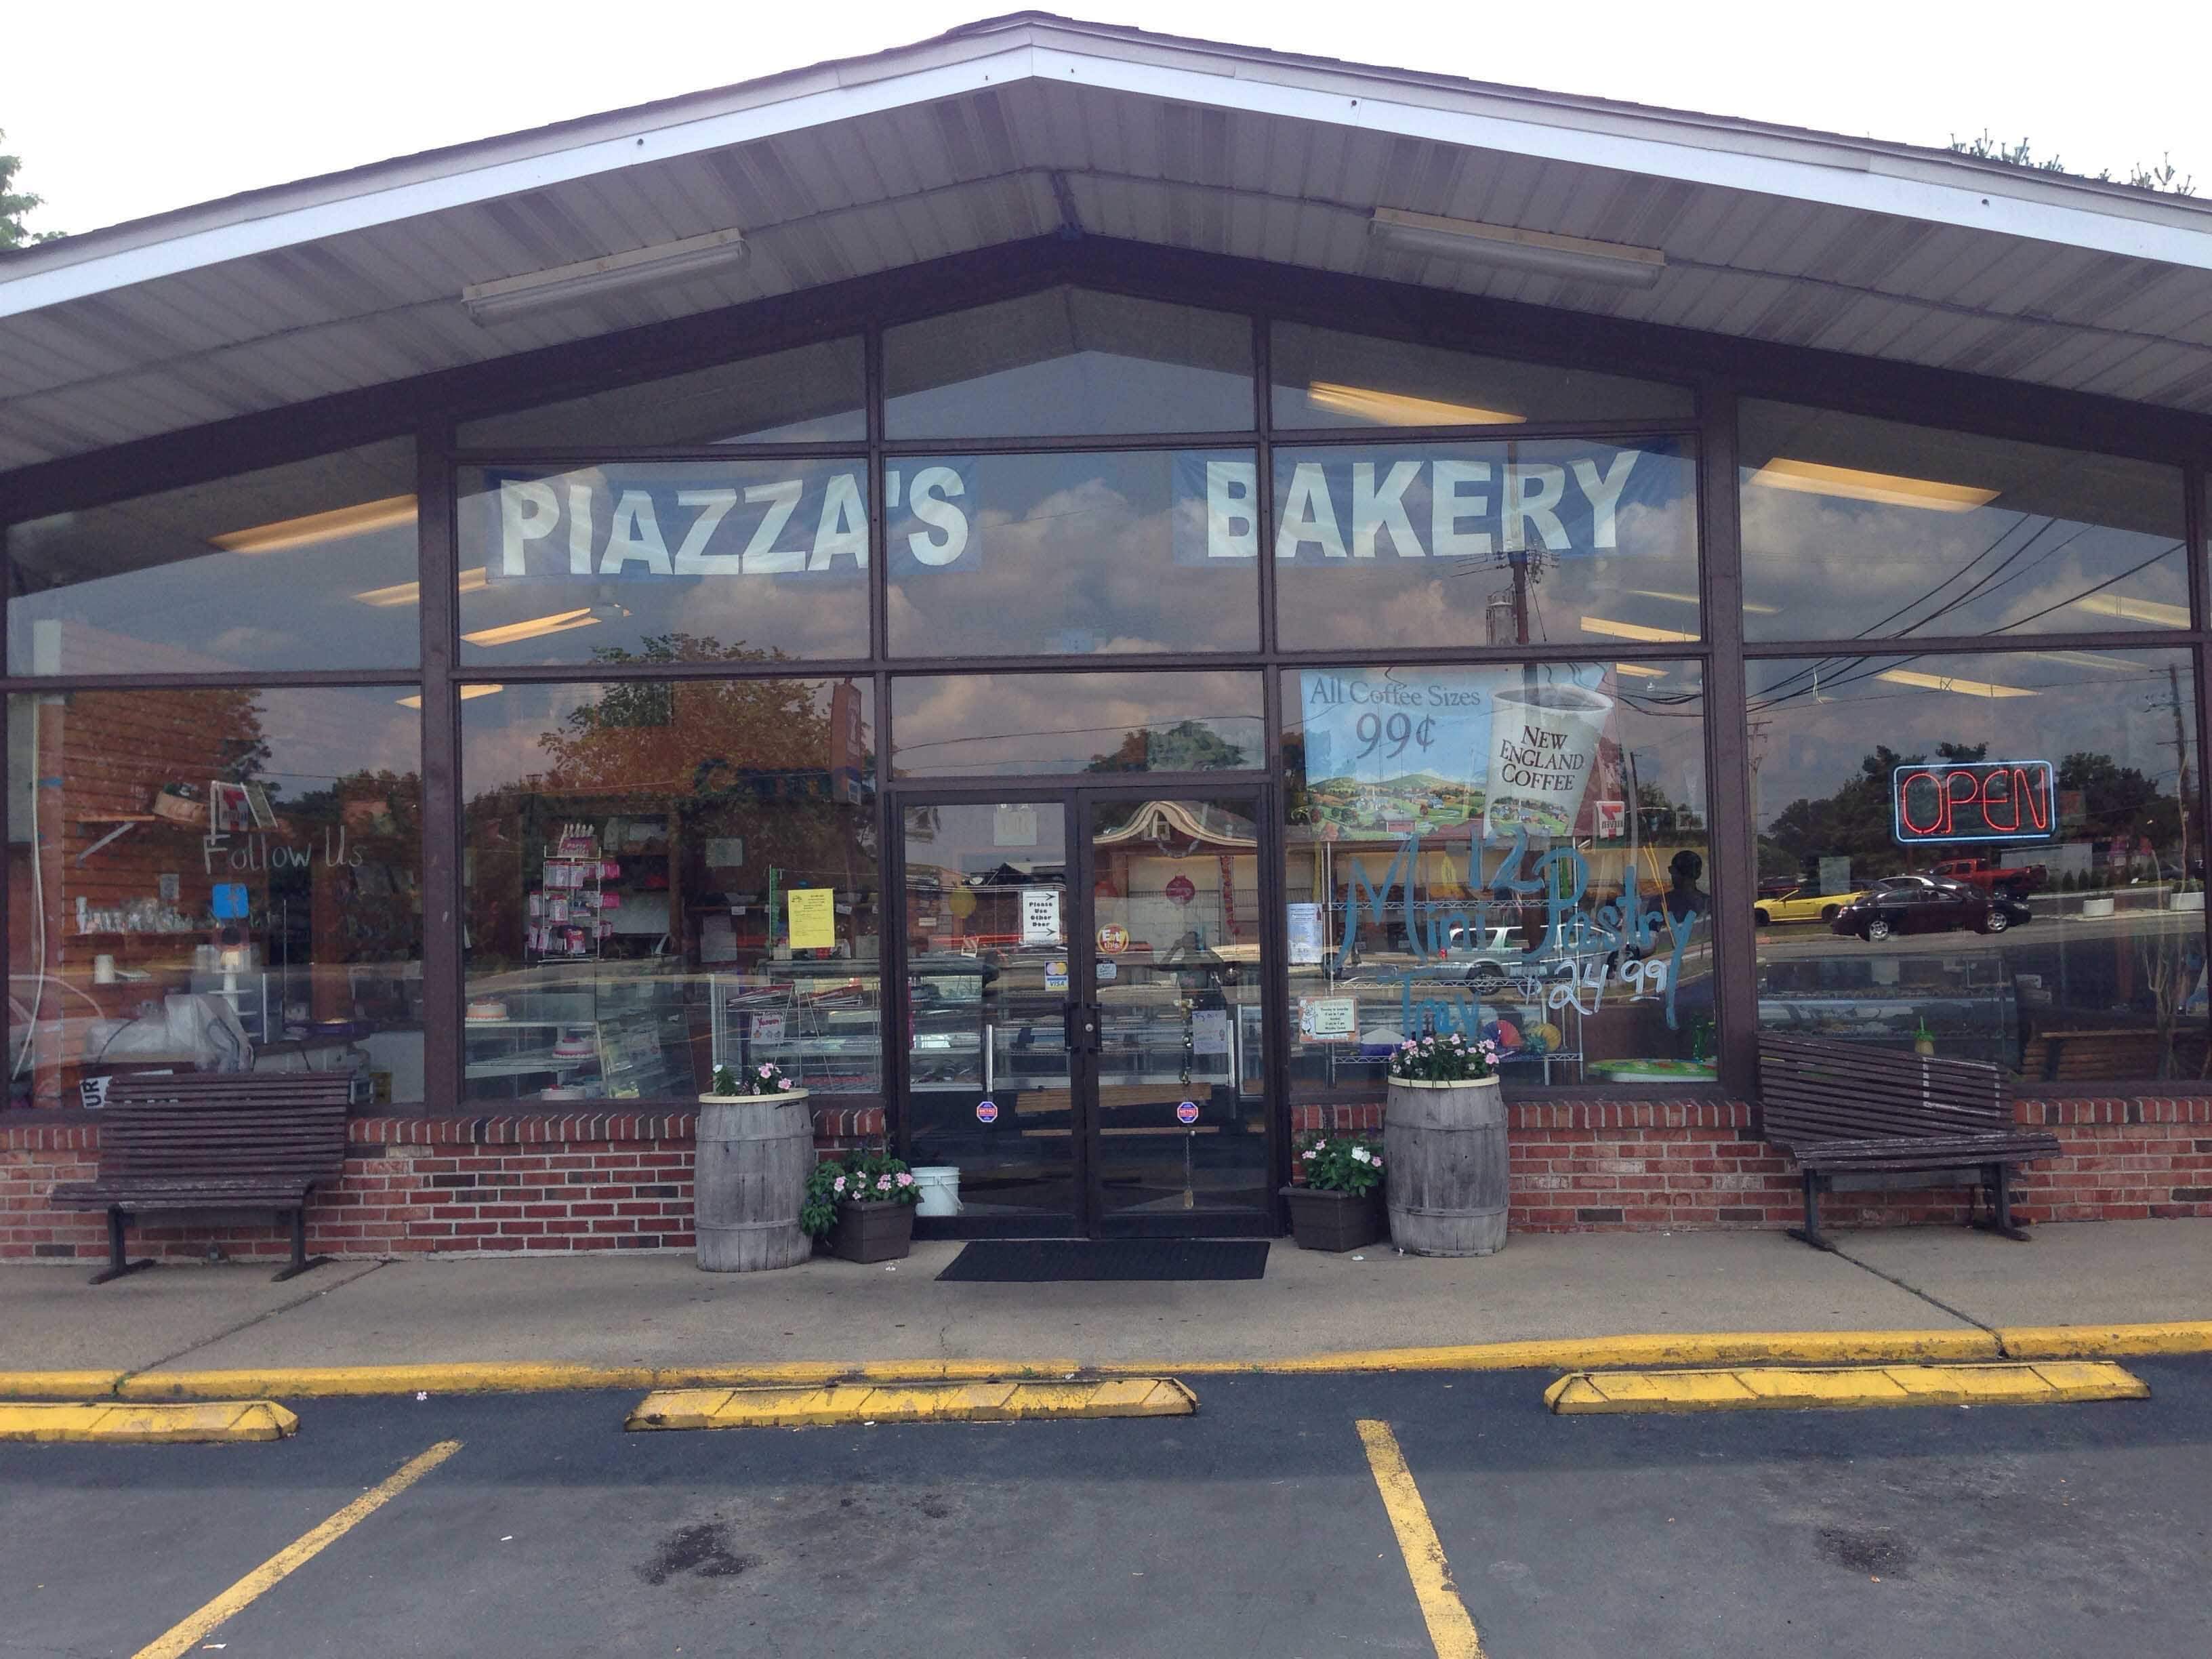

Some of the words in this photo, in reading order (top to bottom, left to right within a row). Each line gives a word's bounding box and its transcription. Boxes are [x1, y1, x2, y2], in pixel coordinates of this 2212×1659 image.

[500, 466, 968, 576] PIAZZA'S
[1206, 450, 1641, 558] BAKERY
[1310, 678, 1345, 704] All
[1349, 681, 1422, 706] Coffee
[1427, 685, 1481, 707] Sizes
[1500, 739, 1584, 771] ENGLAND
[1521, 725, 1568, 750] NEW
[1501, 763, 1576, 791] COFFEE
[1902, 767, 2047, 834] OPEN
[203, 833, 312, 875] Follow
[1469, 827, 1546, 893] 12
[1334, 832, 1487, 968] Mini
[1521, 846, 1697, 1031] Pastry
